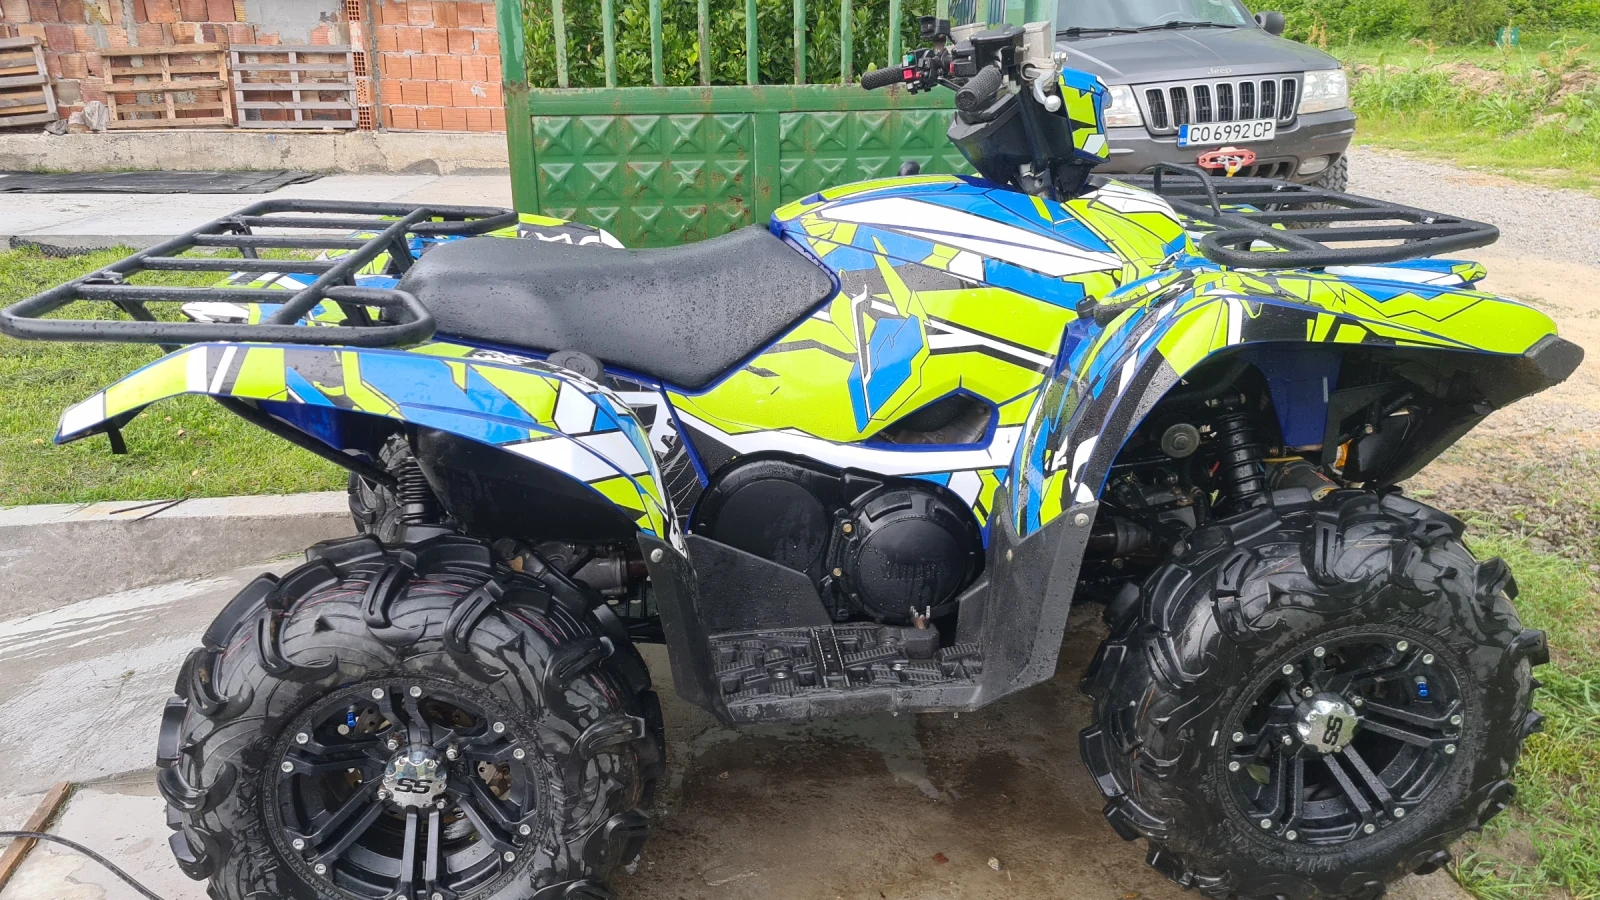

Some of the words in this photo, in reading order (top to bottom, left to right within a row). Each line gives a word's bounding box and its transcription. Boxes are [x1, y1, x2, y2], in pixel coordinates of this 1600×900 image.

[1207, 67, 1232, 75] Jeep
[1190, 126, 1211, 142] CO
[1213, 123, 1251, 141] 6992
[1253, 121, 1273, 138] CP
